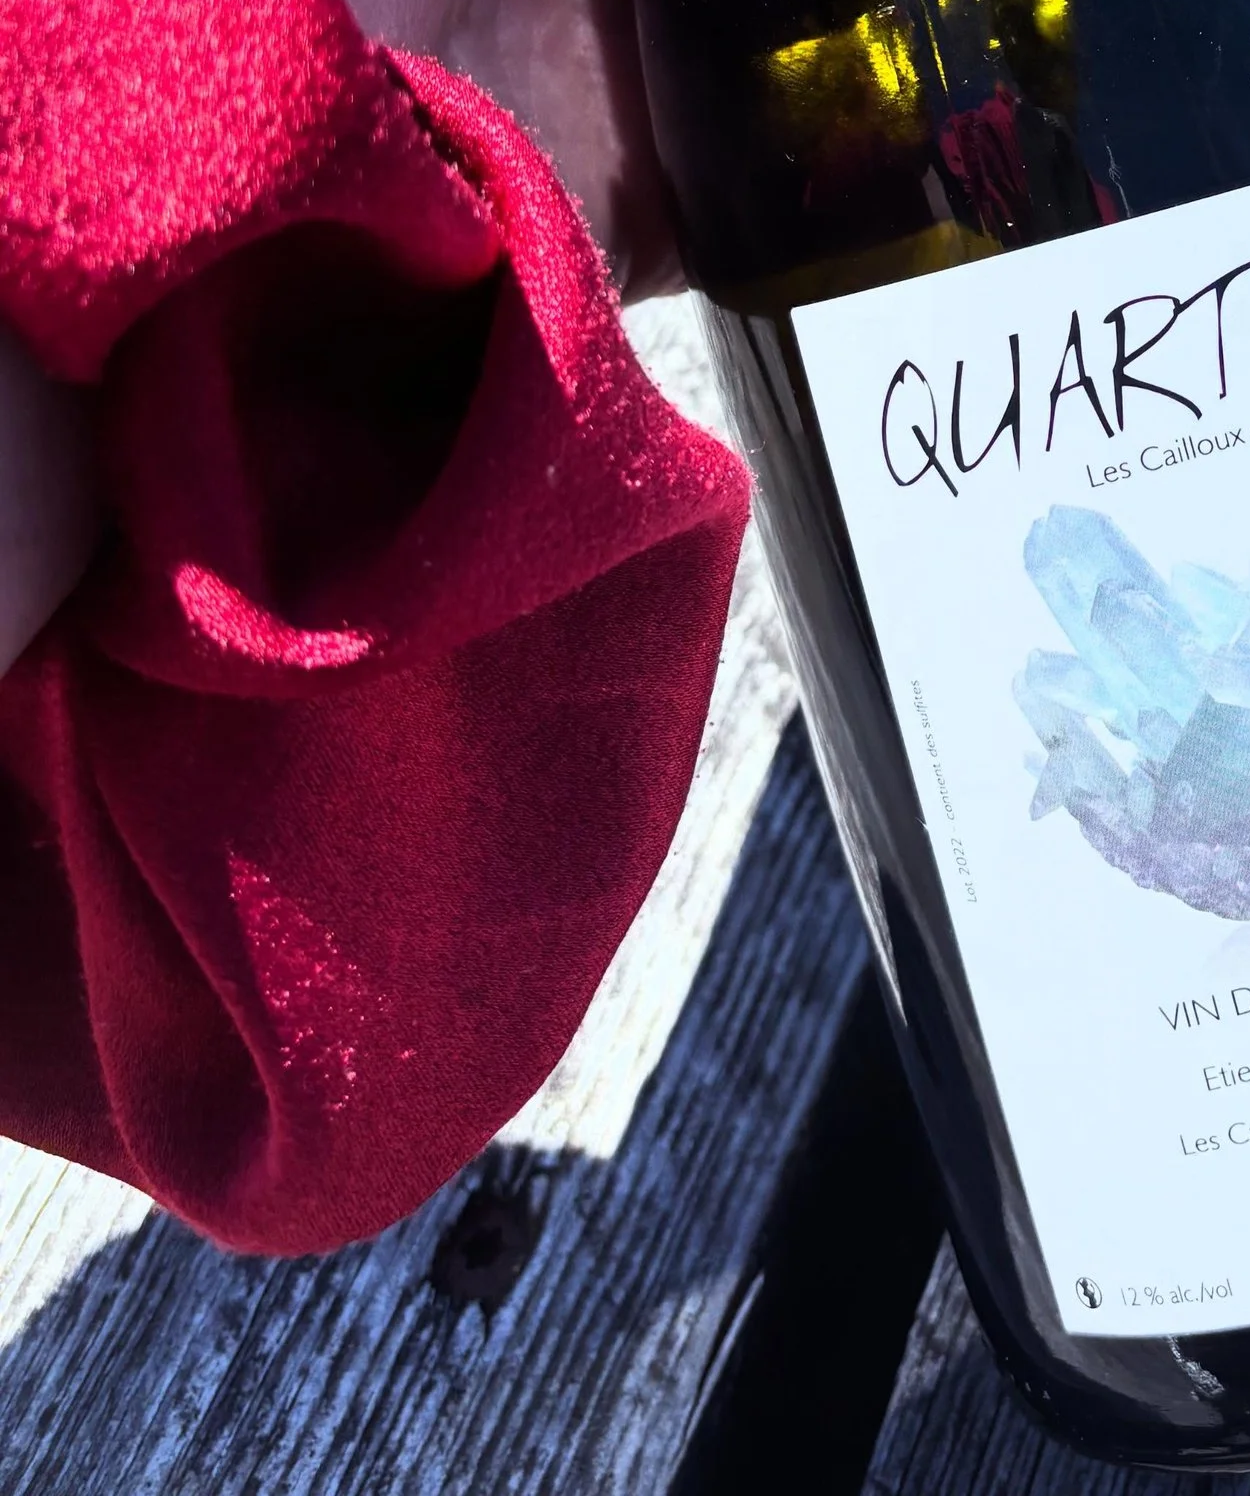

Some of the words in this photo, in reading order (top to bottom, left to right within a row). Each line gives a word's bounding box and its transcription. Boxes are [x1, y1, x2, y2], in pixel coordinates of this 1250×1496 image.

[1085, 461, 1132, 489] Les
[1139, 427, 1247, 472] Cailloux
[910, 680, 931, 729] sulfites
[925, 733, 938, 758] des
[932, 762, 955, 821] contient
[950, 838, 970, 876] 2022
[1158, 994, 1221, 1032] VIN
[1179, 1134, 1221, 1156] Les
